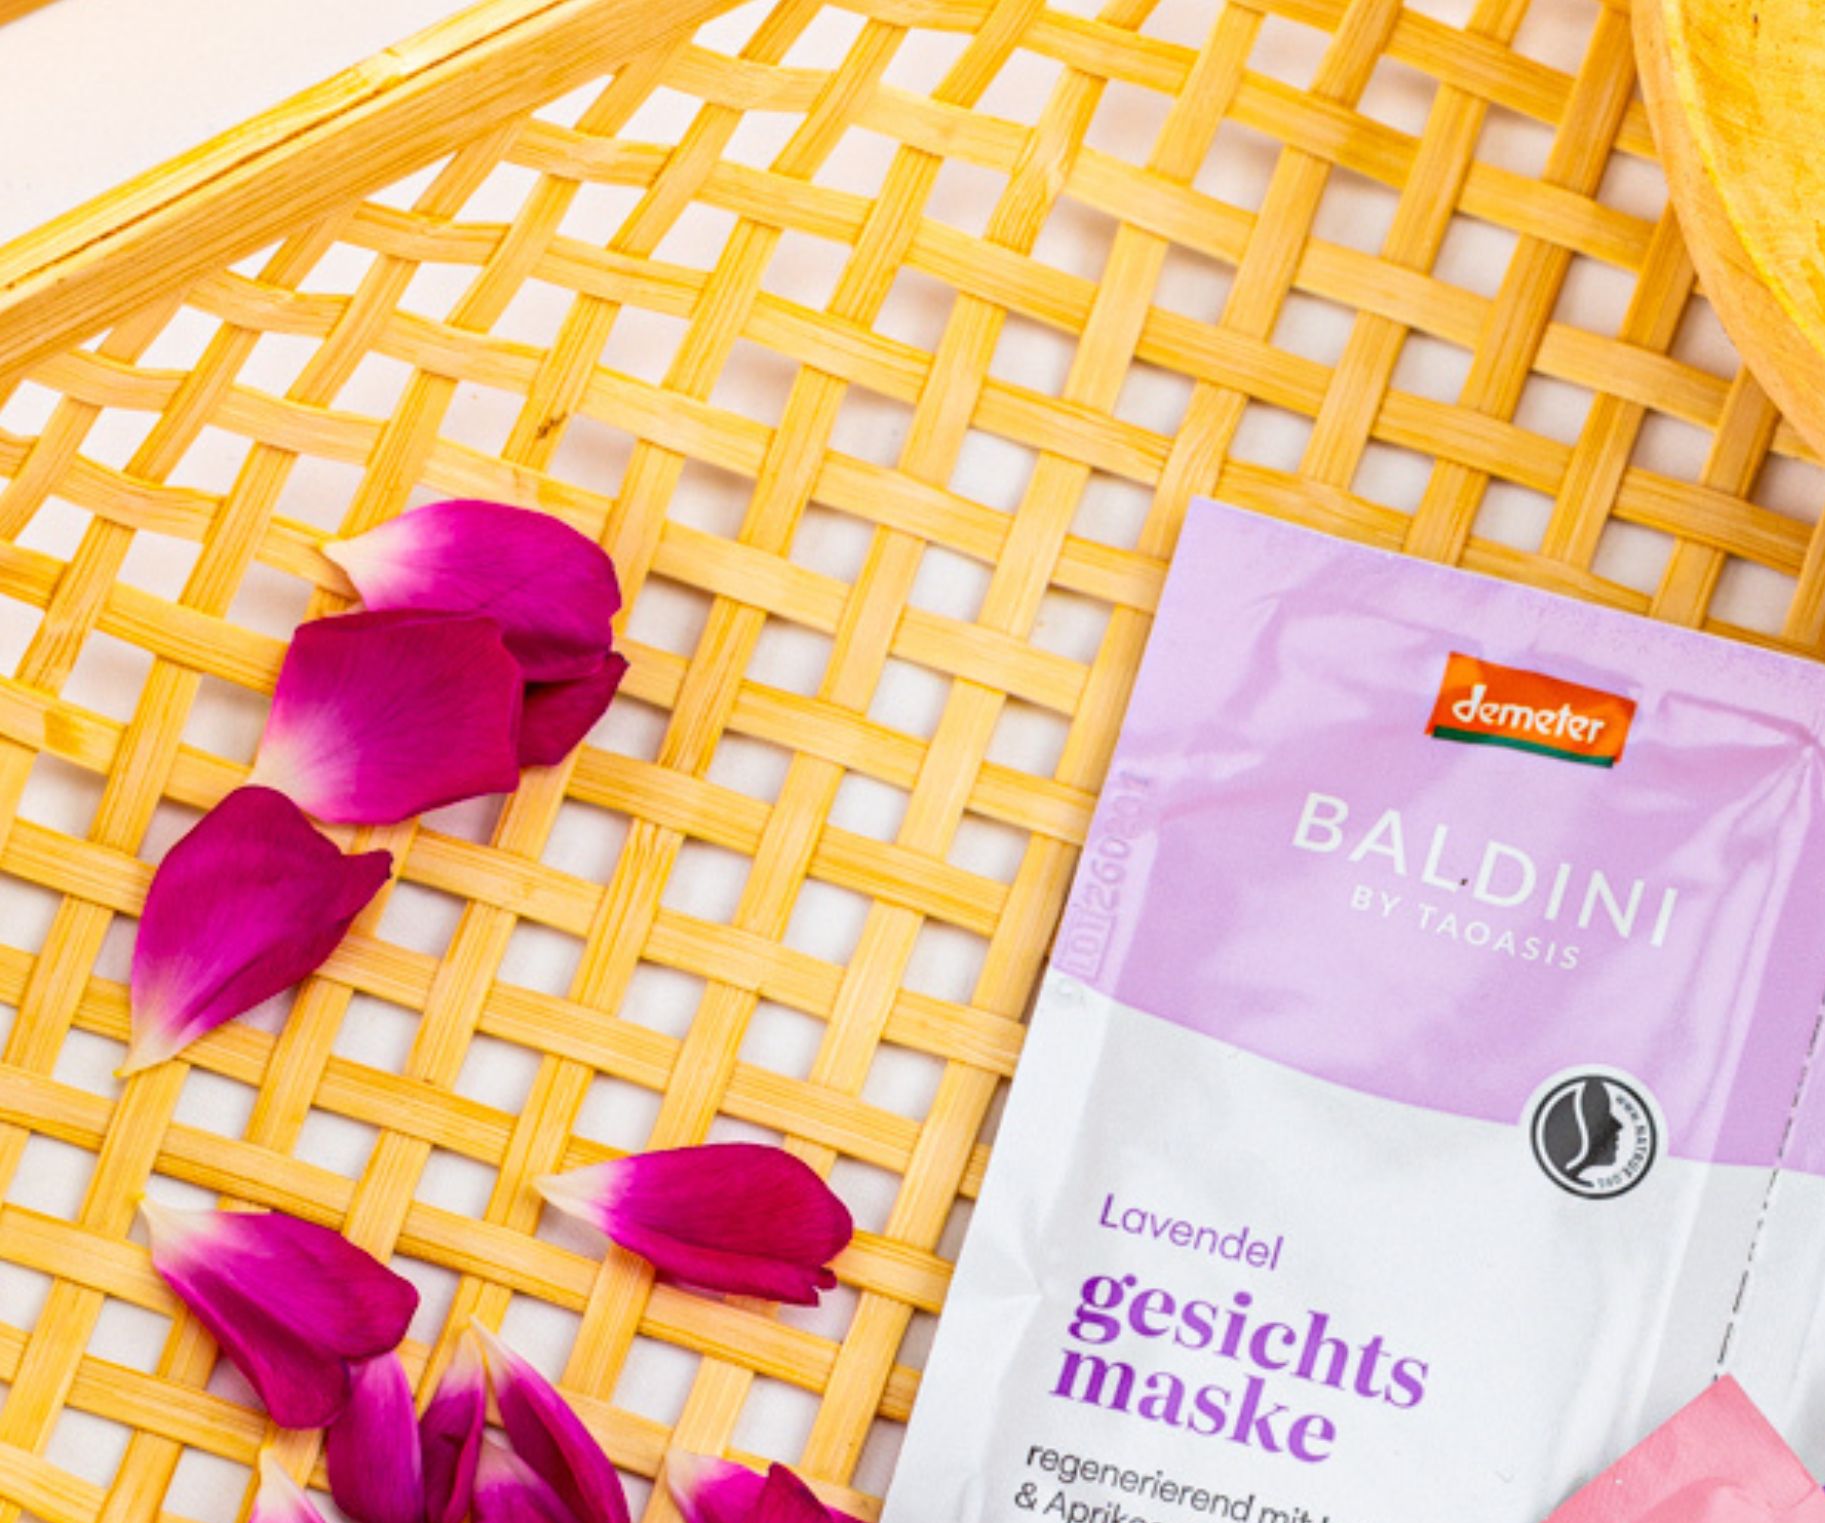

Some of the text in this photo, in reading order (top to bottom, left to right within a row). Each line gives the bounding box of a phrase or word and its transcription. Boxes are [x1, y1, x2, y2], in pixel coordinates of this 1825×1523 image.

[1452, 684, 1605, 745] demeter
[1292, 791, 1679, 948] BALDINI
[1350, 884, 1582, 971] BY TAOASIS
[1100, 1193, 1284, 1271] Lavendel
[1068, 1272, 1430, 1410] gesichts
[1048, 1347, 1337, 1464] maske
[1014, 1482, 1038, 1512] &
[1026, 1440, 1257, 1523] regenerierend
